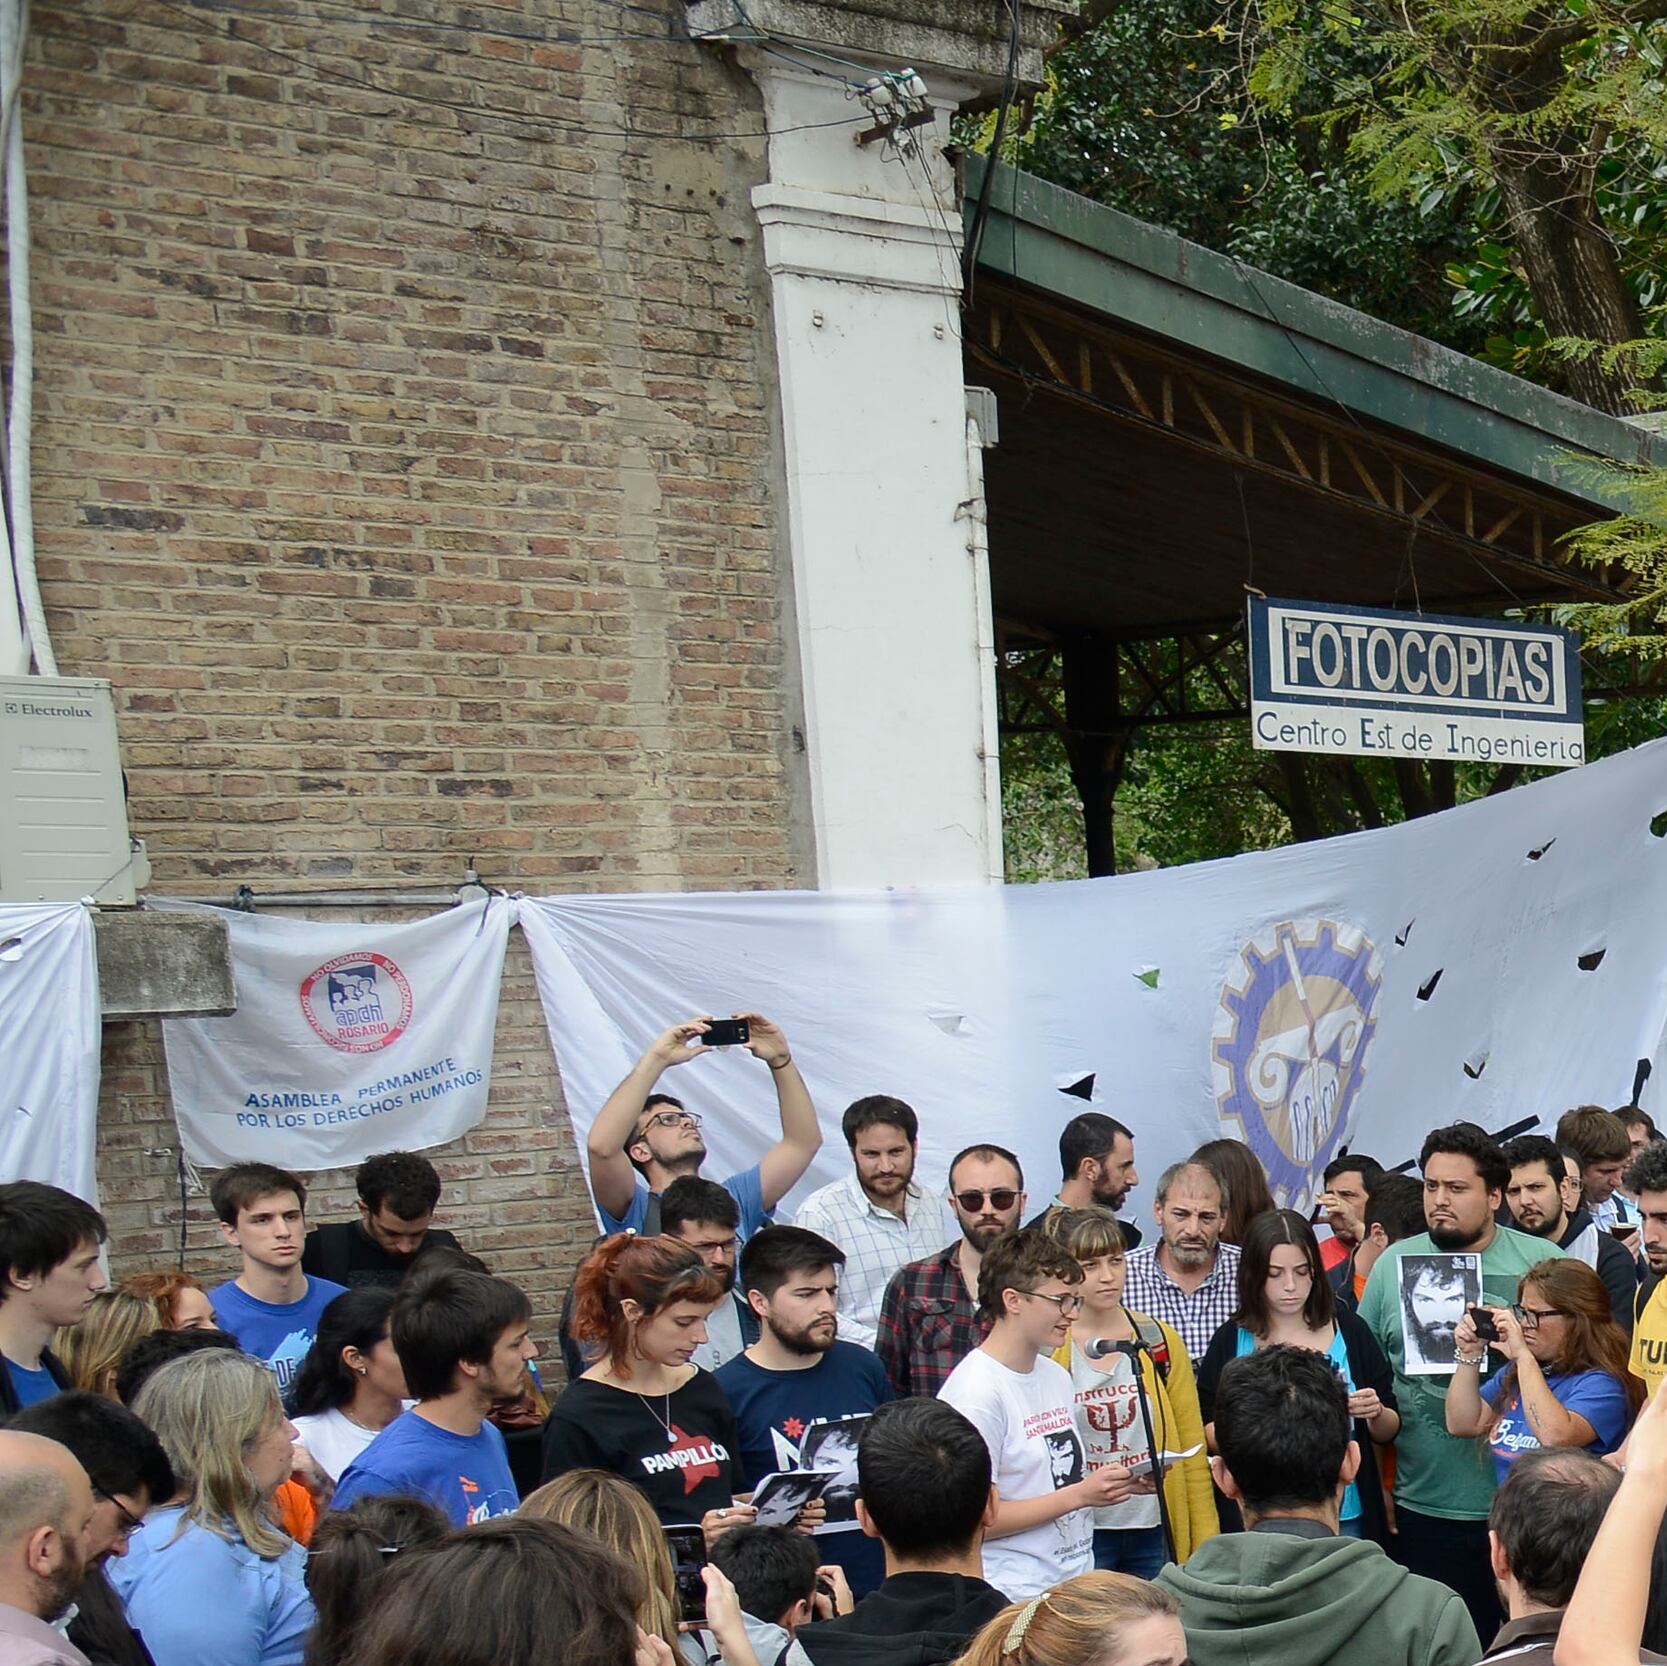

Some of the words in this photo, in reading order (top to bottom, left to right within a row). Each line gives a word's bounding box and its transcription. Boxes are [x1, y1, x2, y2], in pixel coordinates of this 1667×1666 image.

[1285, 617, 1550, 703] FOTOCOPIAS
[22, 703, 93, 718] Electrolux
[1257, 711, 1347, 747] Centro
[1360, 718, 1395, 750] Est
[1402, 725, 1433, 752] de
[1446, 724, 1584, 761] Ingenieria
[337, 1022, 390, 1040] ROSARIO
[236, 1112, 271, 1129] POR
[275, 1113, 306, 1129] LOS
[313, 1095, 404, 1127] DERECHOS
[410, 1068, 483, 1105] HUMANOS
[245, 1092, 342, 1109] ASAMBLEA
[358, 1057, 457, 1100] PERMANENTE
